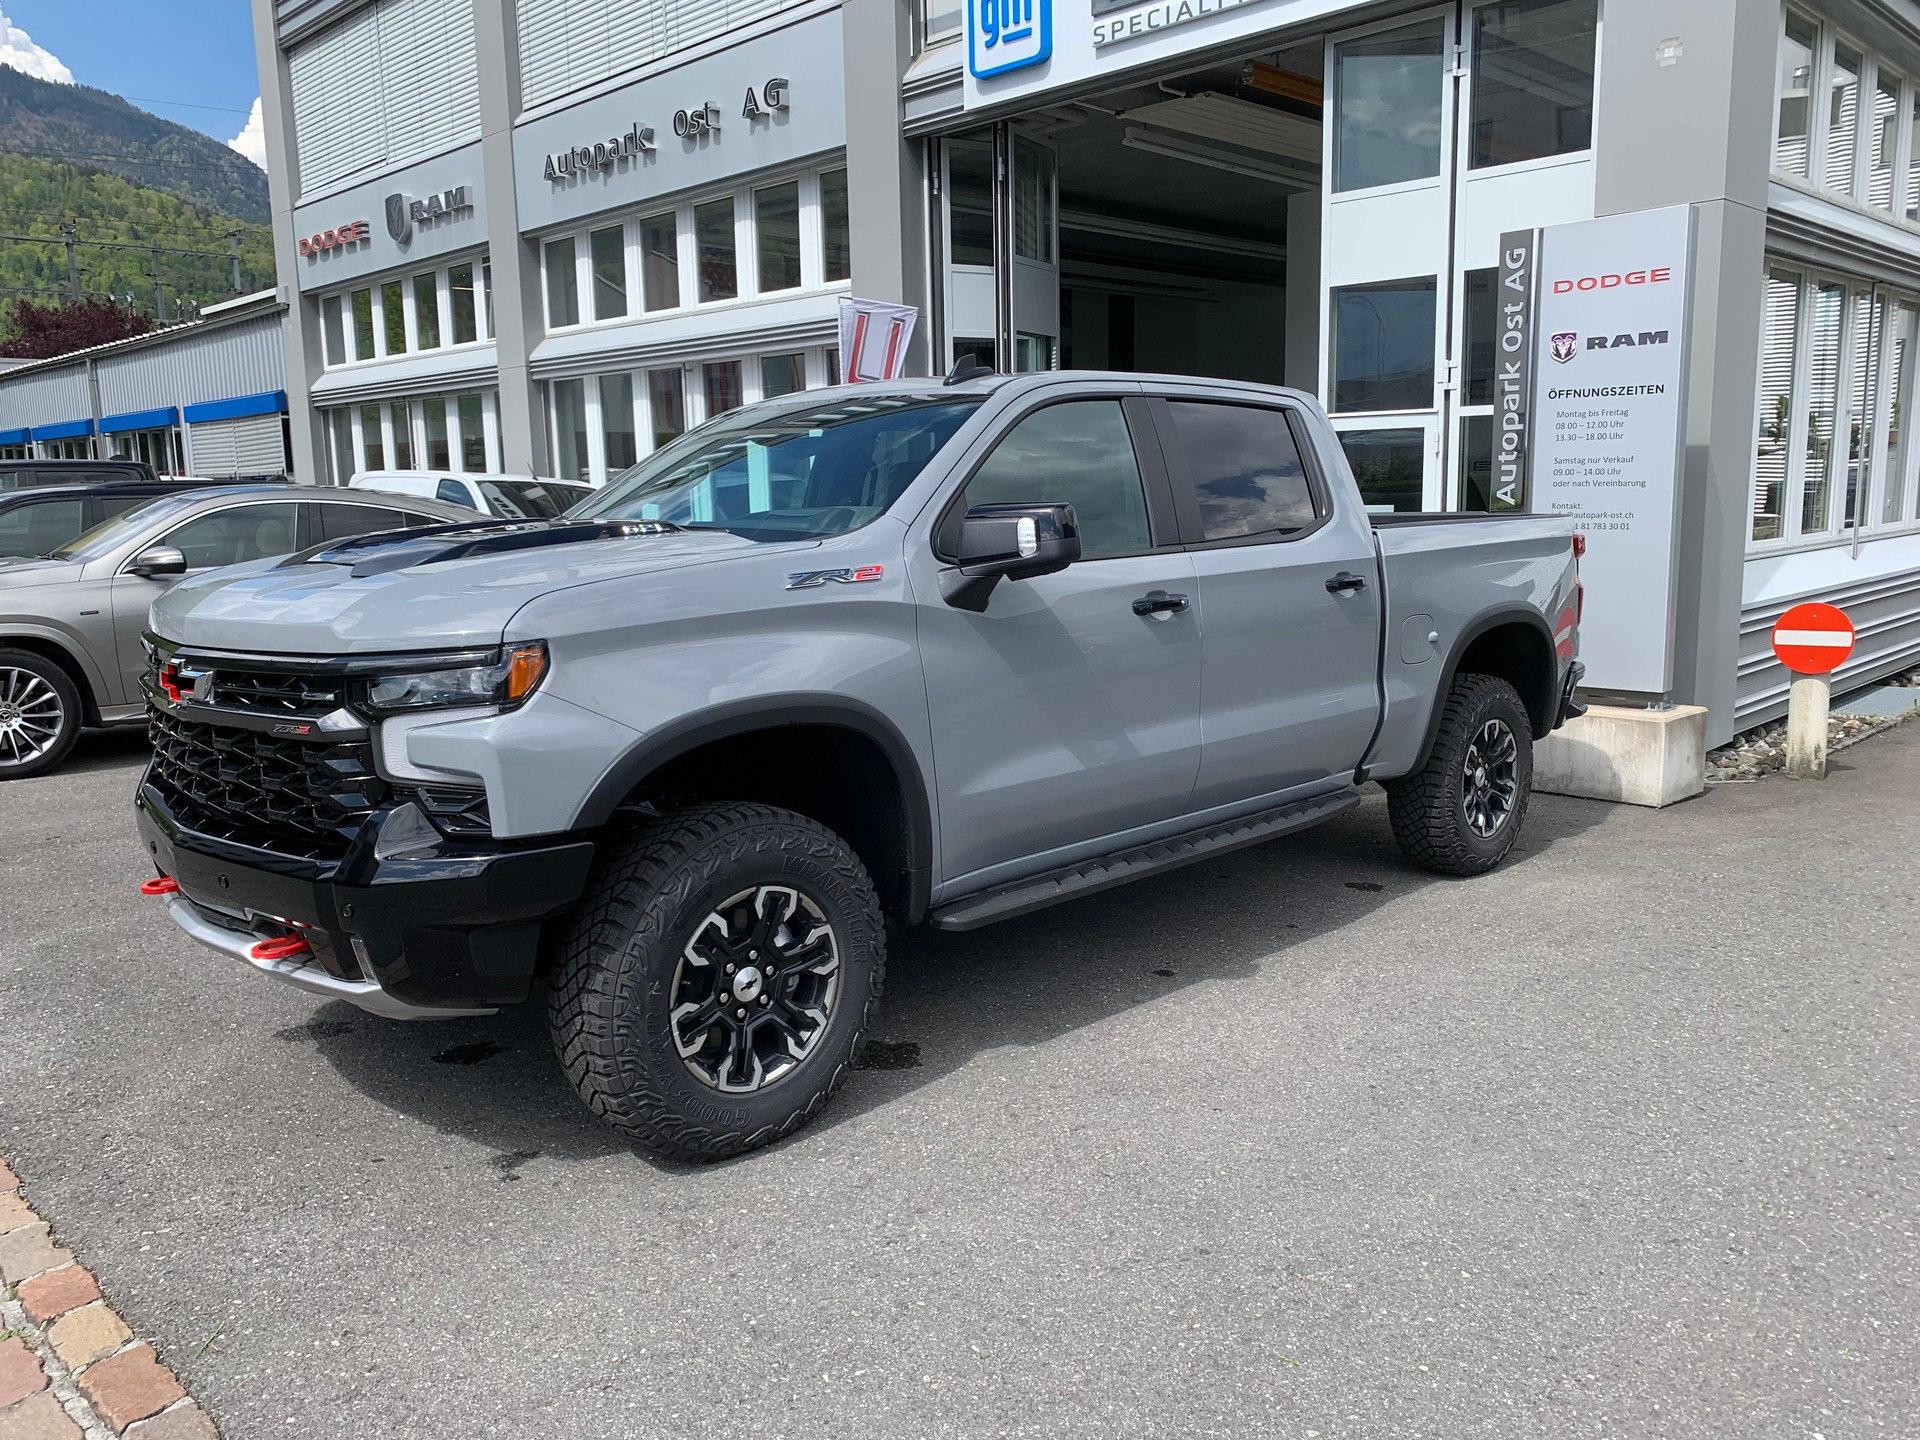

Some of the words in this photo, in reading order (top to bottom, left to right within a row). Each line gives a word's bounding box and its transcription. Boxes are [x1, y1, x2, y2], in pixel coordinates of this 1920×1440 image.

[543, 122, 650, 181] Autopark
[673, 101, 716, 138] Ost
[743, 78, 785, 118] AG
[409, 186, 468, 222] RAM
[299, 220, 367, 256] DODGE
[1505, 247, 1526, 292] AG
[1553, 267, 1671, 294] DODGE
[1502, 302, 1523, 353] Ost
[1586, 330, 1669, 350] RAM
[1548, 384, 1665, 400] ÖFFNUNGSZEITEN
[1556, 410, 1587, 419] Montag
[1588, 409, 1600, 417] bis
[1601, 409, 1629, 417] Freitag
[1496, 360, 1525, 505] Autopark
[1556, 422, 1577, 430] 08.00
[1586, 421, 1608, 429] 12.00
[1610, 420, 1624, 428] Uhr
[1585, 433, 1607, 441] 18.00
[1609, 432, 1624, 440] Uhr
[1554, 457, 1586, 465] Samstag
[1603, 455, 1634, 463] Verkauf
[1553, 468, 1575, 476] 09.00
[1553, 480, 1570, 488] oder
[1572, 479, 1590, 487] nach
[1593, 479, 1646, 488] Vereinbarung
[1552, 502, 1583, 510] Kontakt:
[1581, 522, 1590, 530] 81
[1593, 522, 1606, 530] 783
[1609, 522, 1619, 530] 30
[1620, 522, 1629, 530] 01
[784, 565, 882, 590] ZR2
[273, 723, 311, 735] ZR2
[782, 855, 868, 963] WRANGLER
